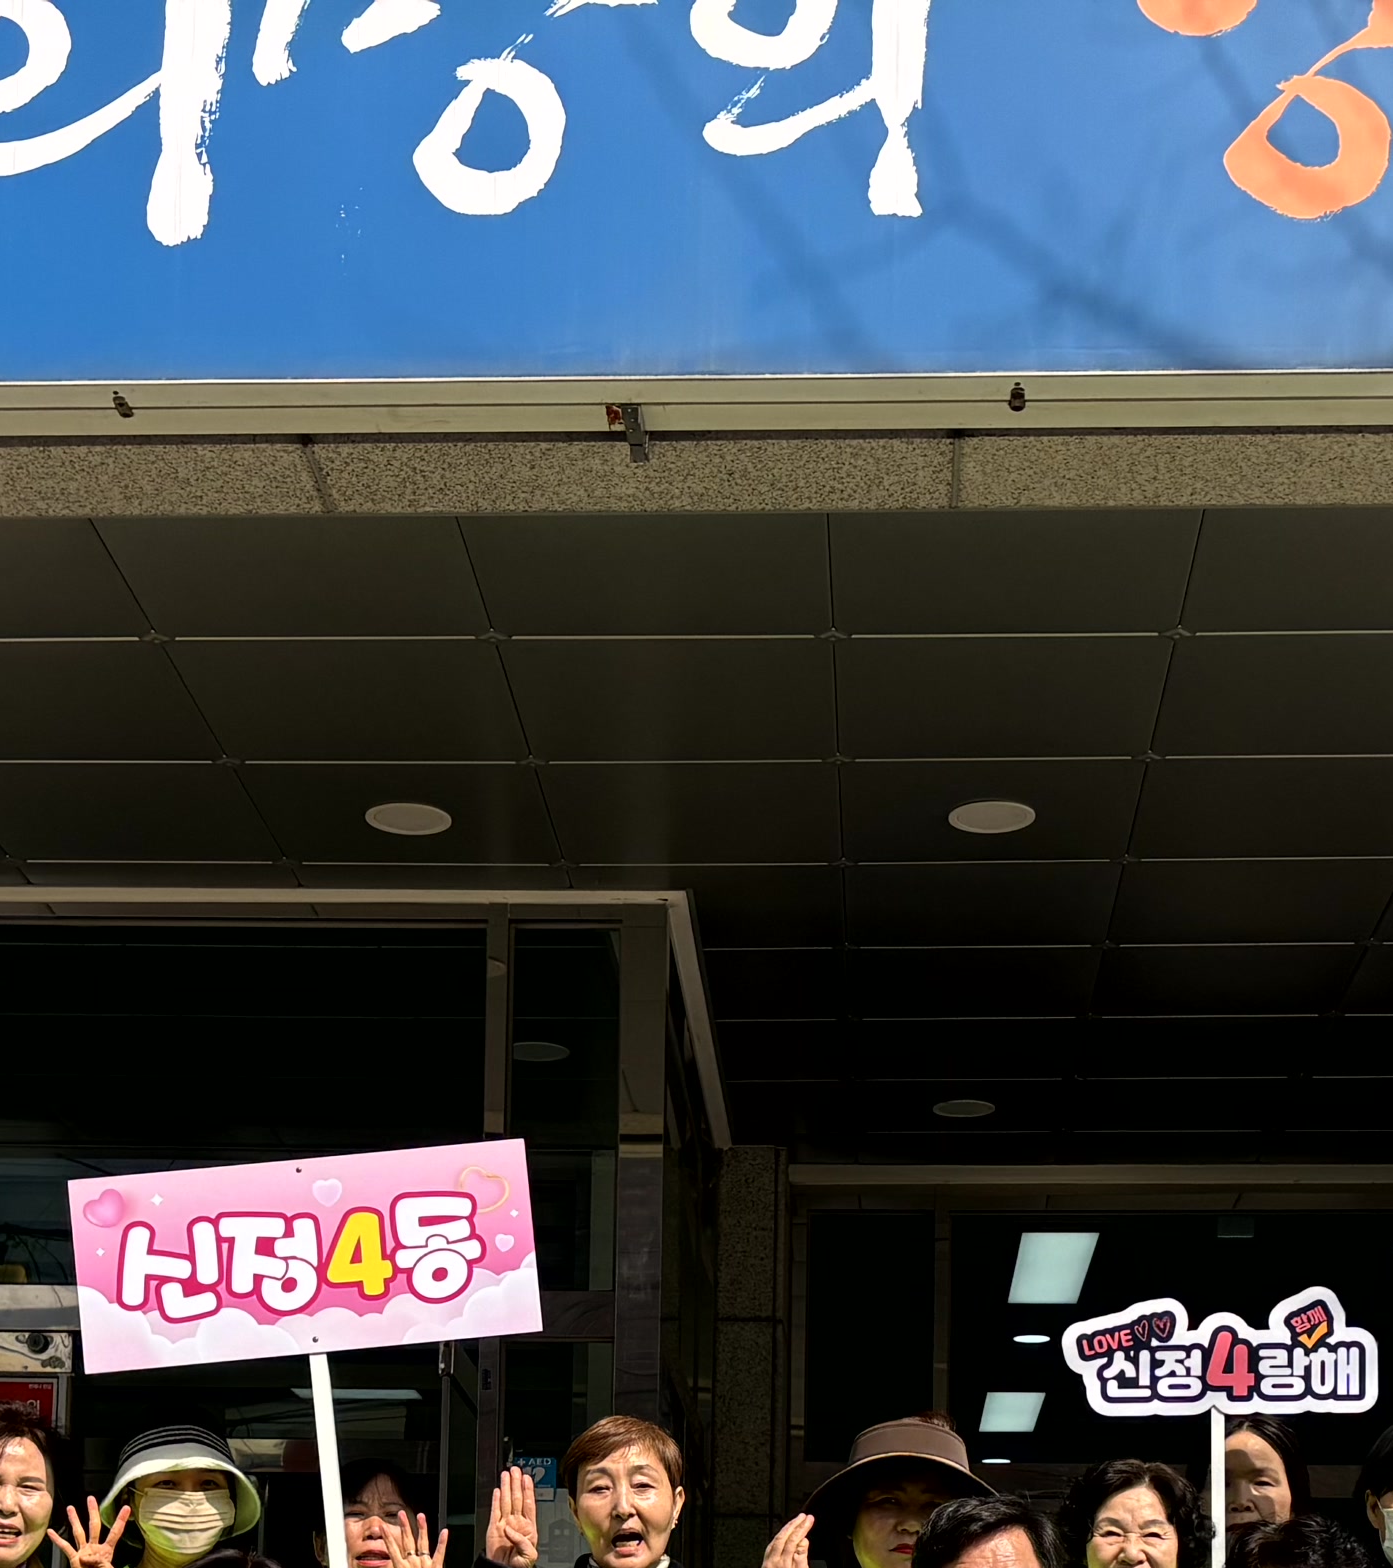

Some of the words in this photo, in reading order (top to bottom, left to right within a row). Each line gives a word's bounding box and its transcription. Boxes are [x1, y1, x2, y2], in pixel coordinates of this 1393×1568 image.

[118, 1192, 483, 1321] 신정4동
[1082, 1328, 1134, 1356] LOVE
[1290, 1305, 1326, 1333] 함께
[1103, 1331, 1360, 1398] 신정4랑해
